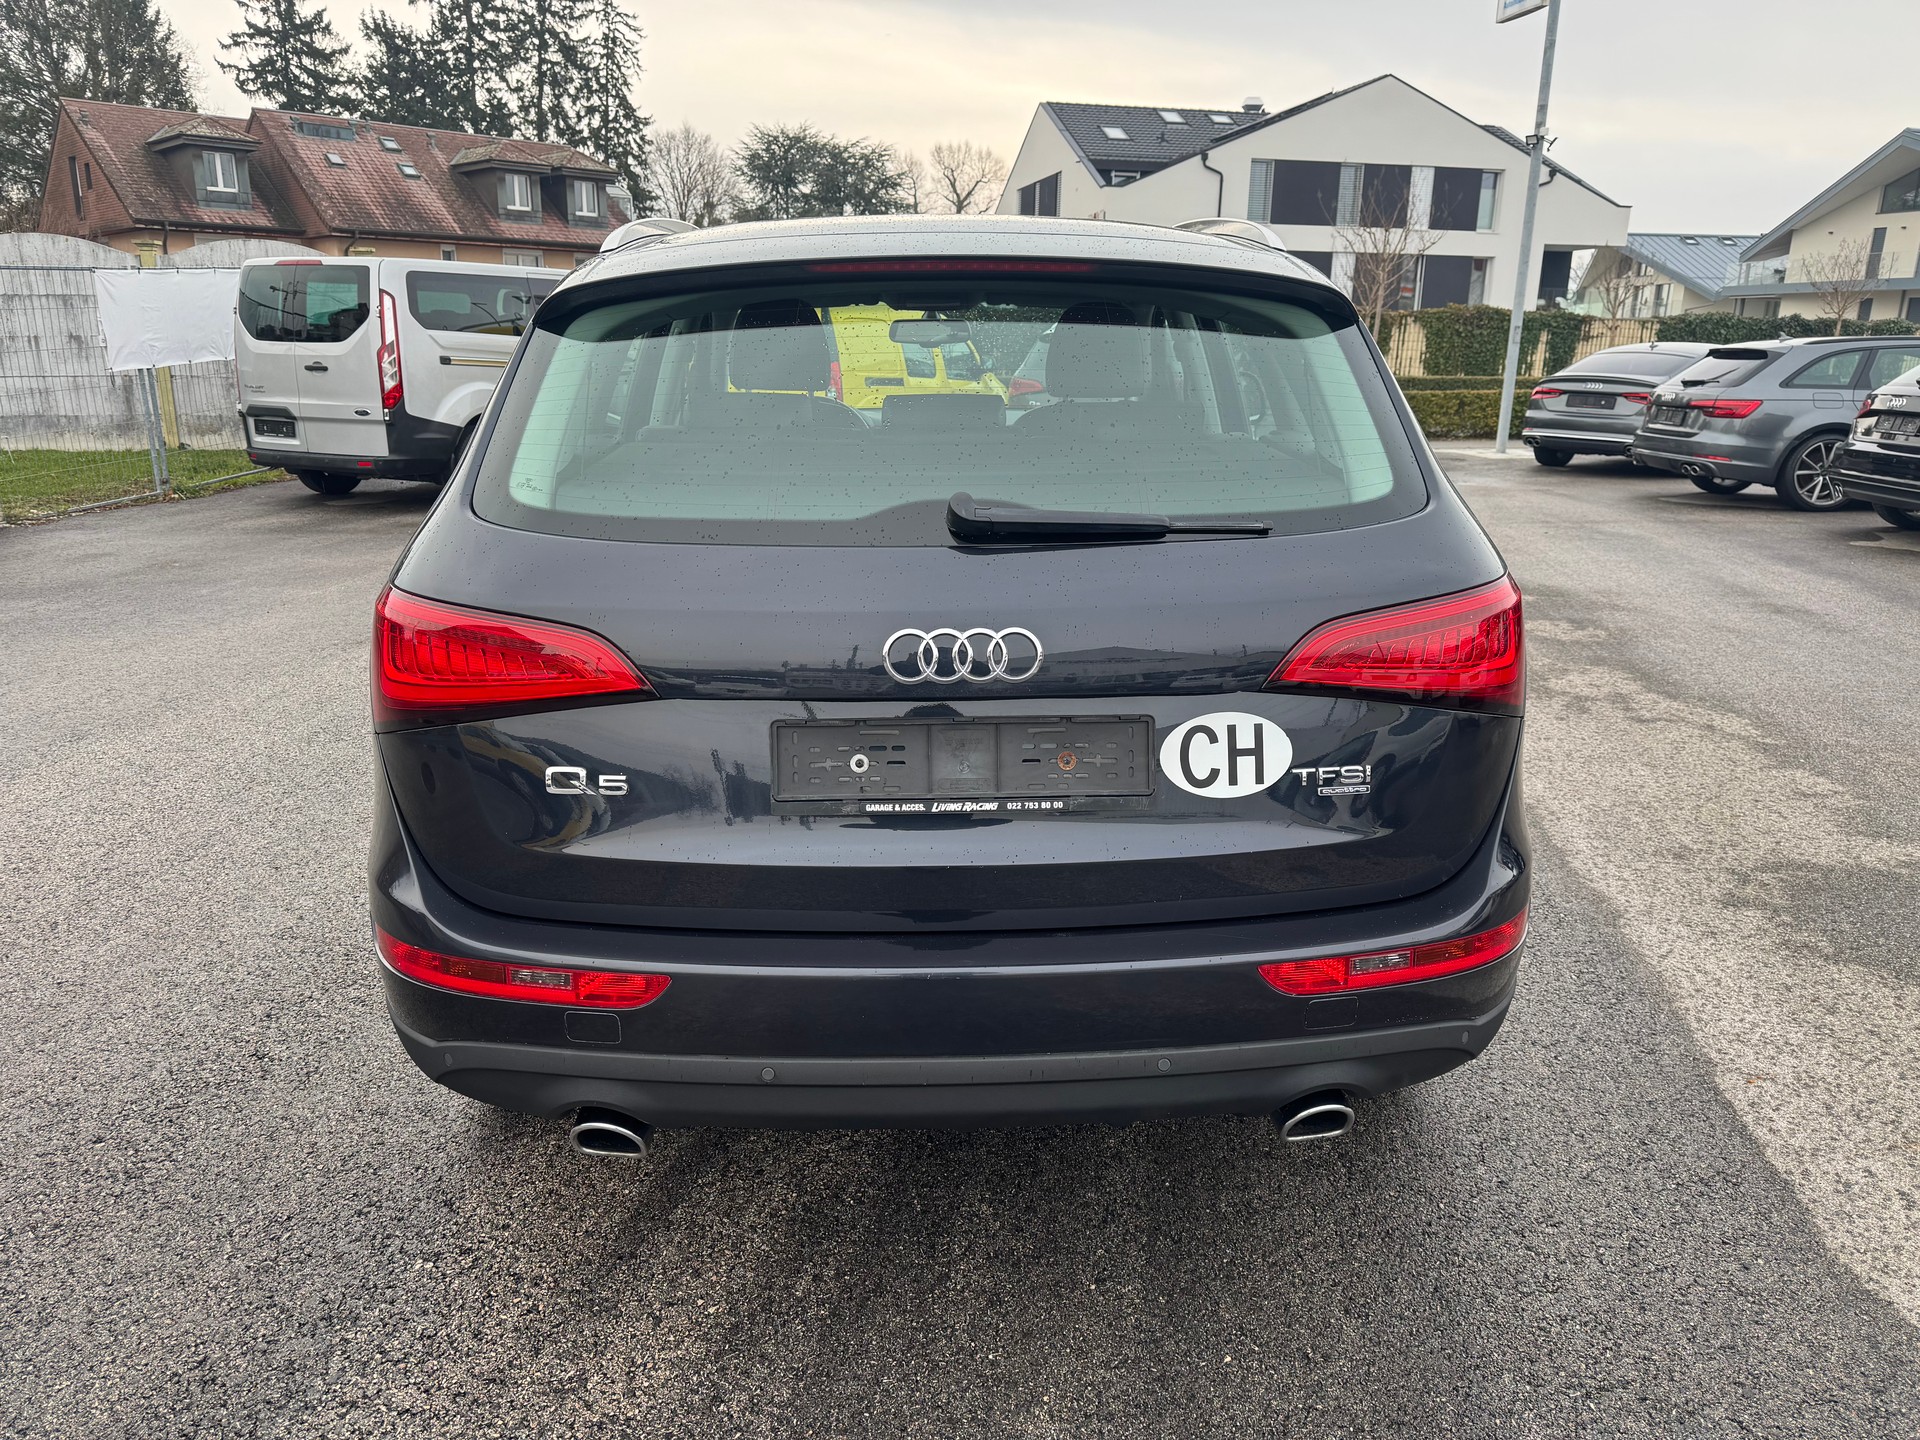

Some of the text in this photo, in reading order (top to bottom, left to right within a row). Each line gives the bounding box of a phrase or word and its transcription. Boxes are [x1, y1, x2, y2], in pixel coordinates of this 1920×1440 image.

[1180, 723, 1265, 788] CH
[545, 766, 628, 796] Q5
[1290, 765, 1371, 786] TFSI
[1322, 787, 1367, 796] quattro
[865, 803, 893, 811] GARAGE
[1006, 802, 1022, 810] 022
[1041, 801, 1051, 809] 80
[1053, 801, 1063, 809] 00
